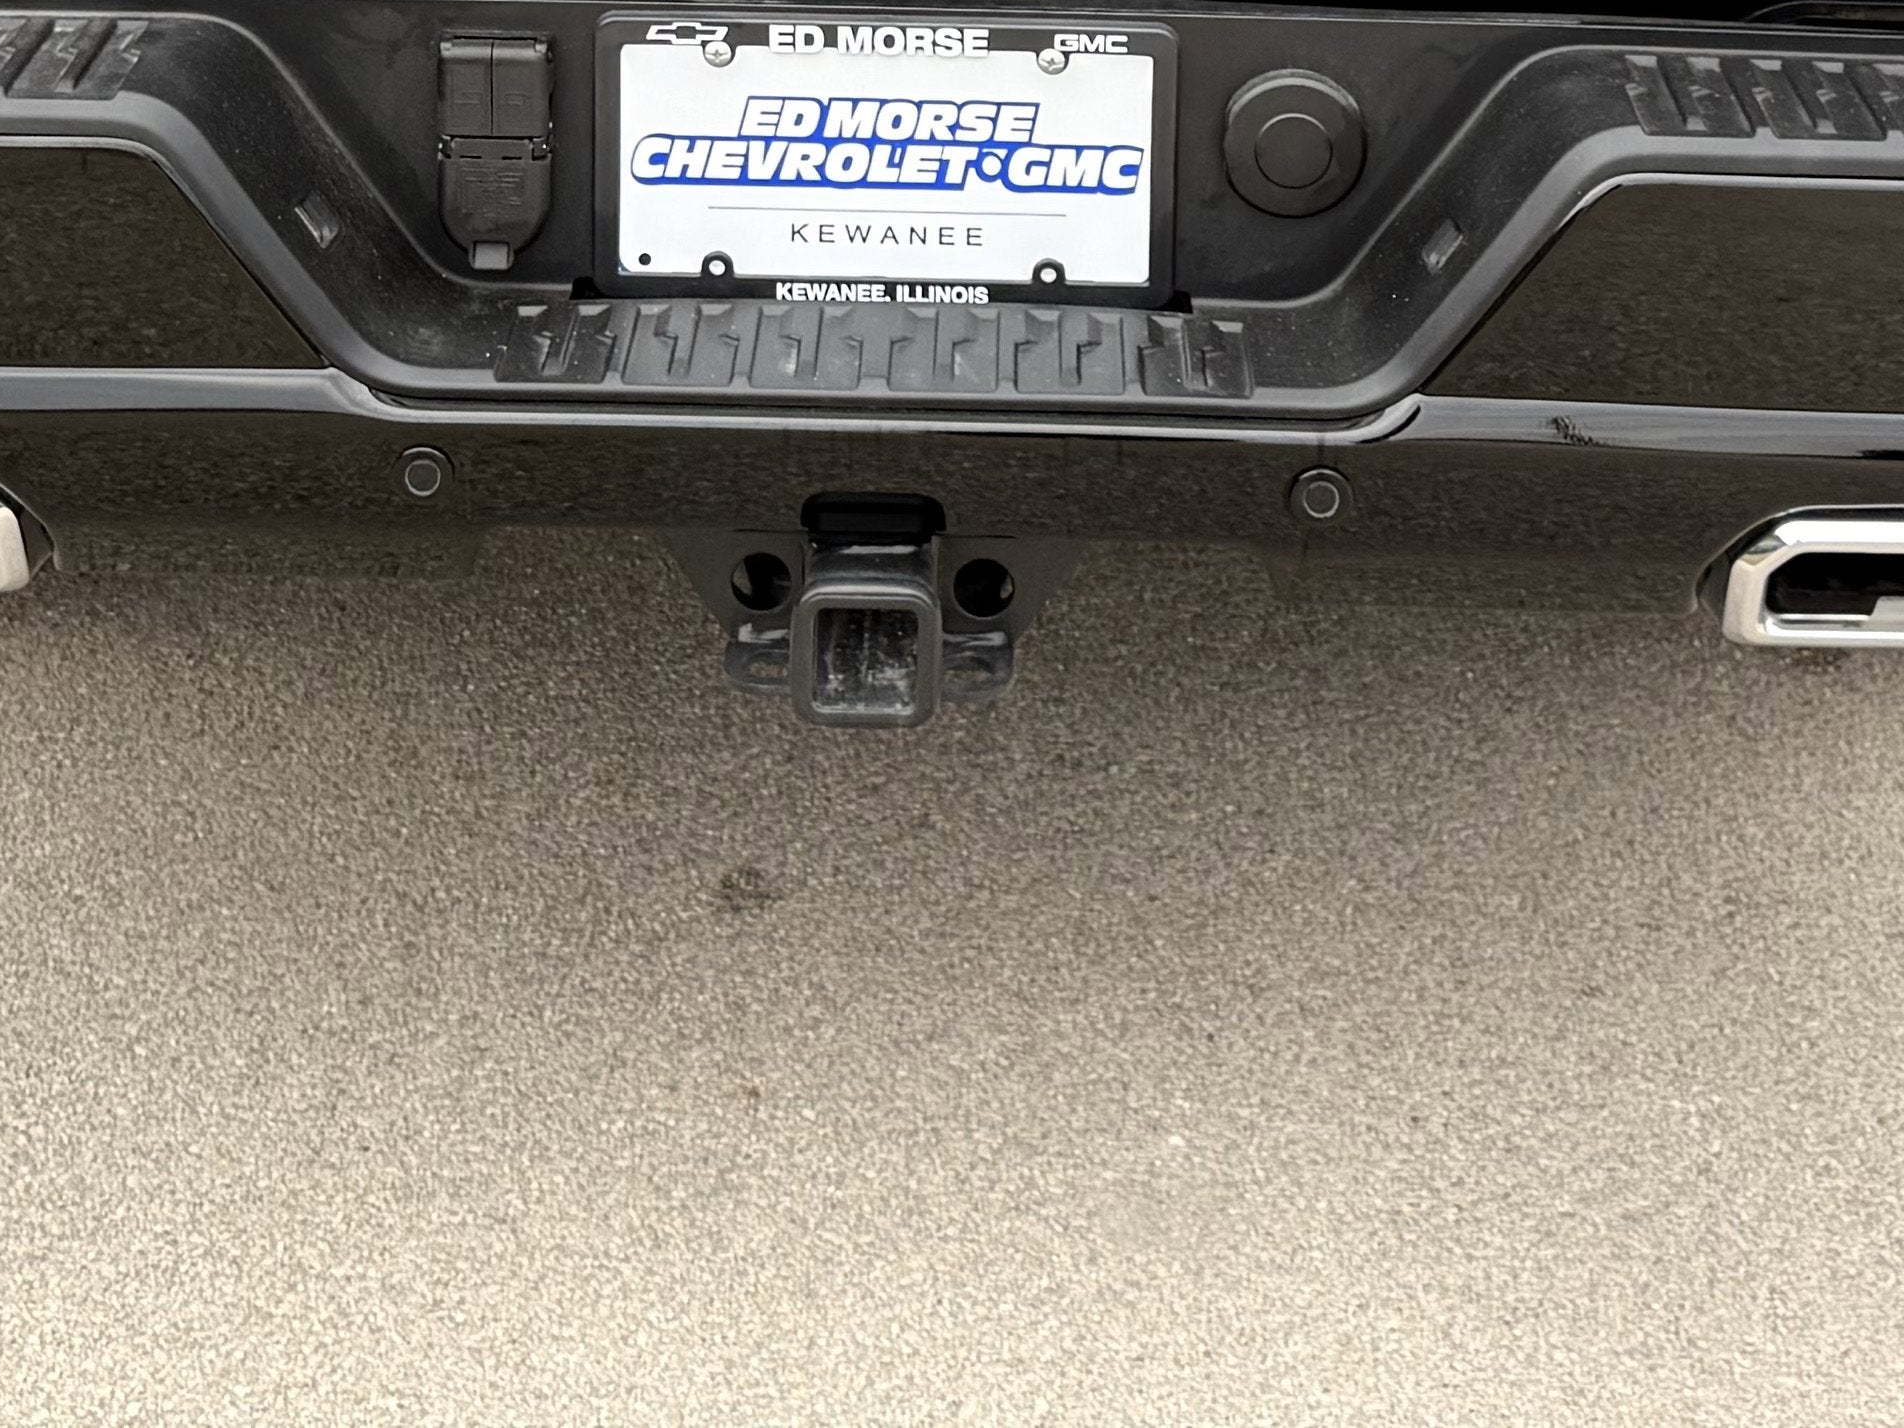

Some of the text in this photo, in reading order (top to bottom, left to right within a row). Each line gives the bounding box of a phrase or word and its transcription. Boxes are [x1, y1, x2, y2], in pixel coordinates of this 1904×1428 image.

[768, 24, 990, 57] ED MORSE
[1053, 33, 1129, 54] GMC
[739, 97, 1039, 143] ED MORSE
[791, 223, 983, 246] KEWANEE
[896, 284, 990, 304] ILLINOIS
